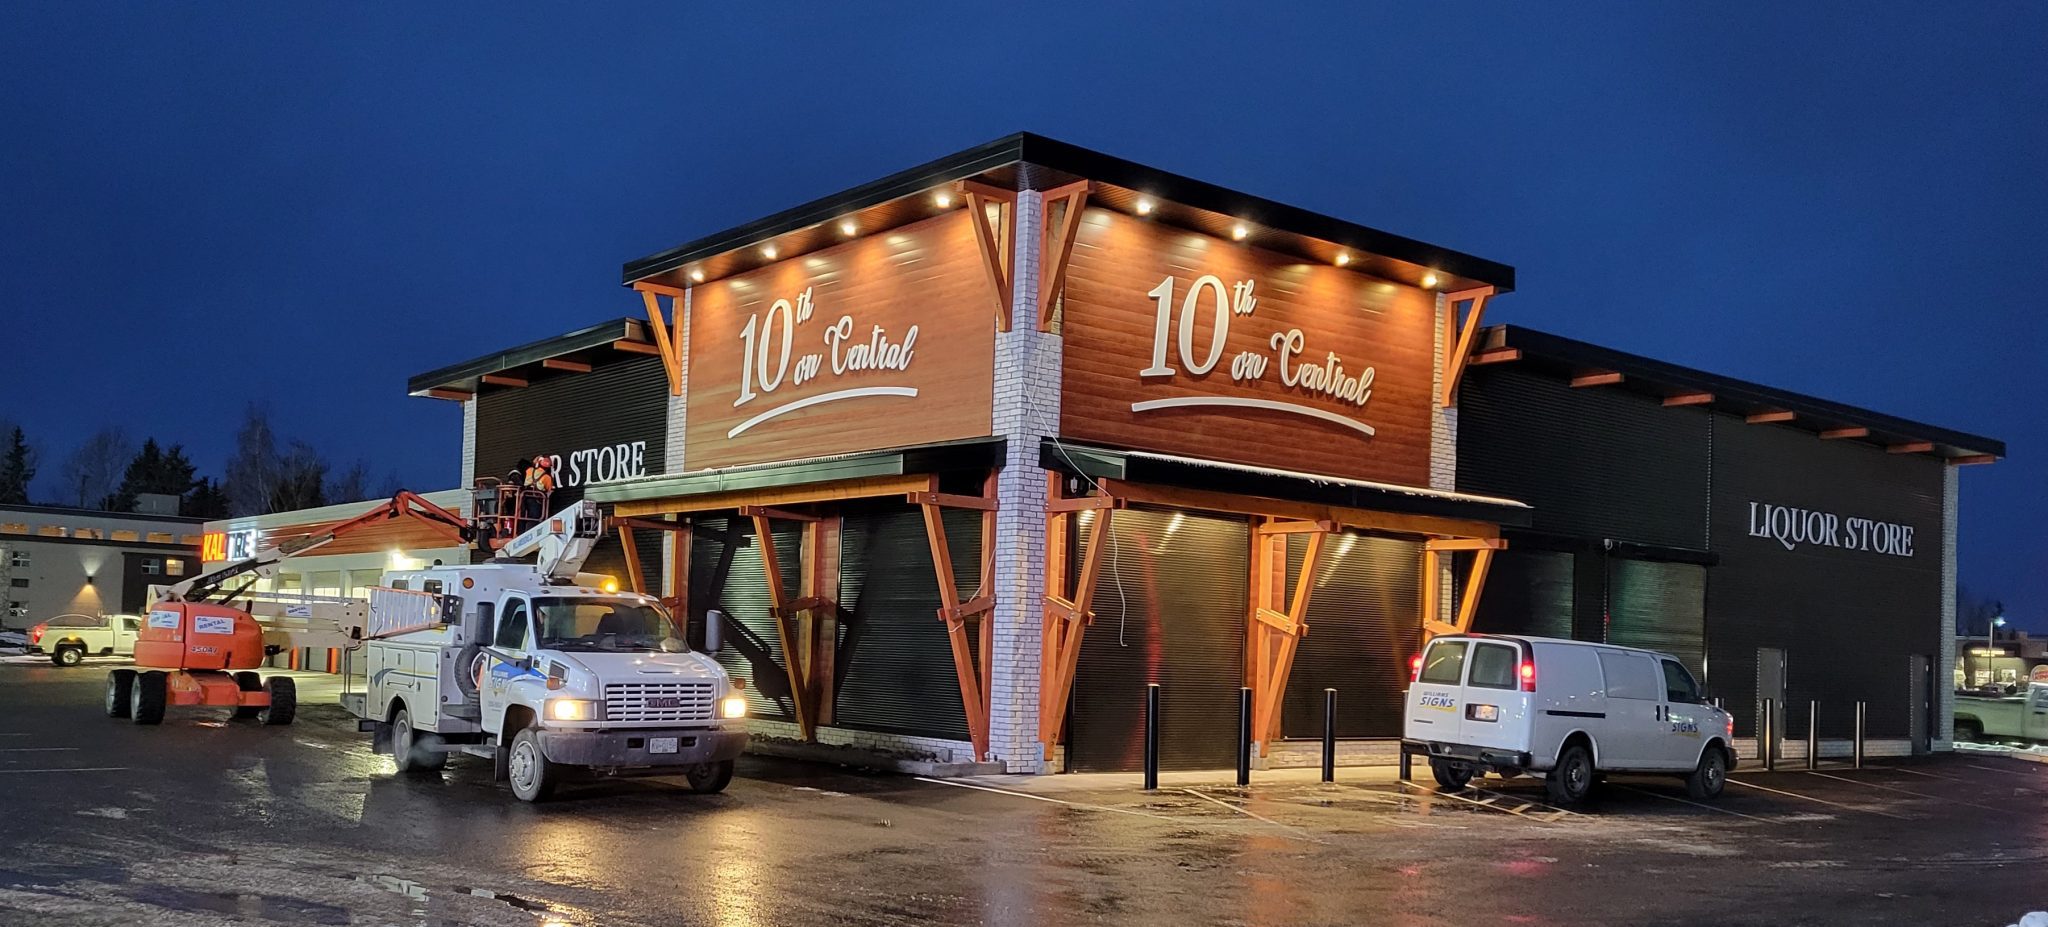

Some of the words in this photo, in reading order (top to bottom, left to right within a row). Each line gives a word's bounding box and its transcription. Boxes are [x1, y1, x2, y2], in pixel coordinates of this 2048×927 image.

[793, 353, 823, 386] on
[824, 315, 919, 375] Central
[1231, 351, 1268, 381] on
[1270, 328, 1376, 406] Central
[568, 440, 646, 487] STORE
[202, 532, 226, 562] KAL
[1748, 501, 1841, 551] LIQUOR
[1845, 516, 1914, 557] STORE
[198, 618, 226, 630] RENTAL
[1420, 696, 1455, 708] SIGNS
[1671, 722, 1698, 733] SIGNS
